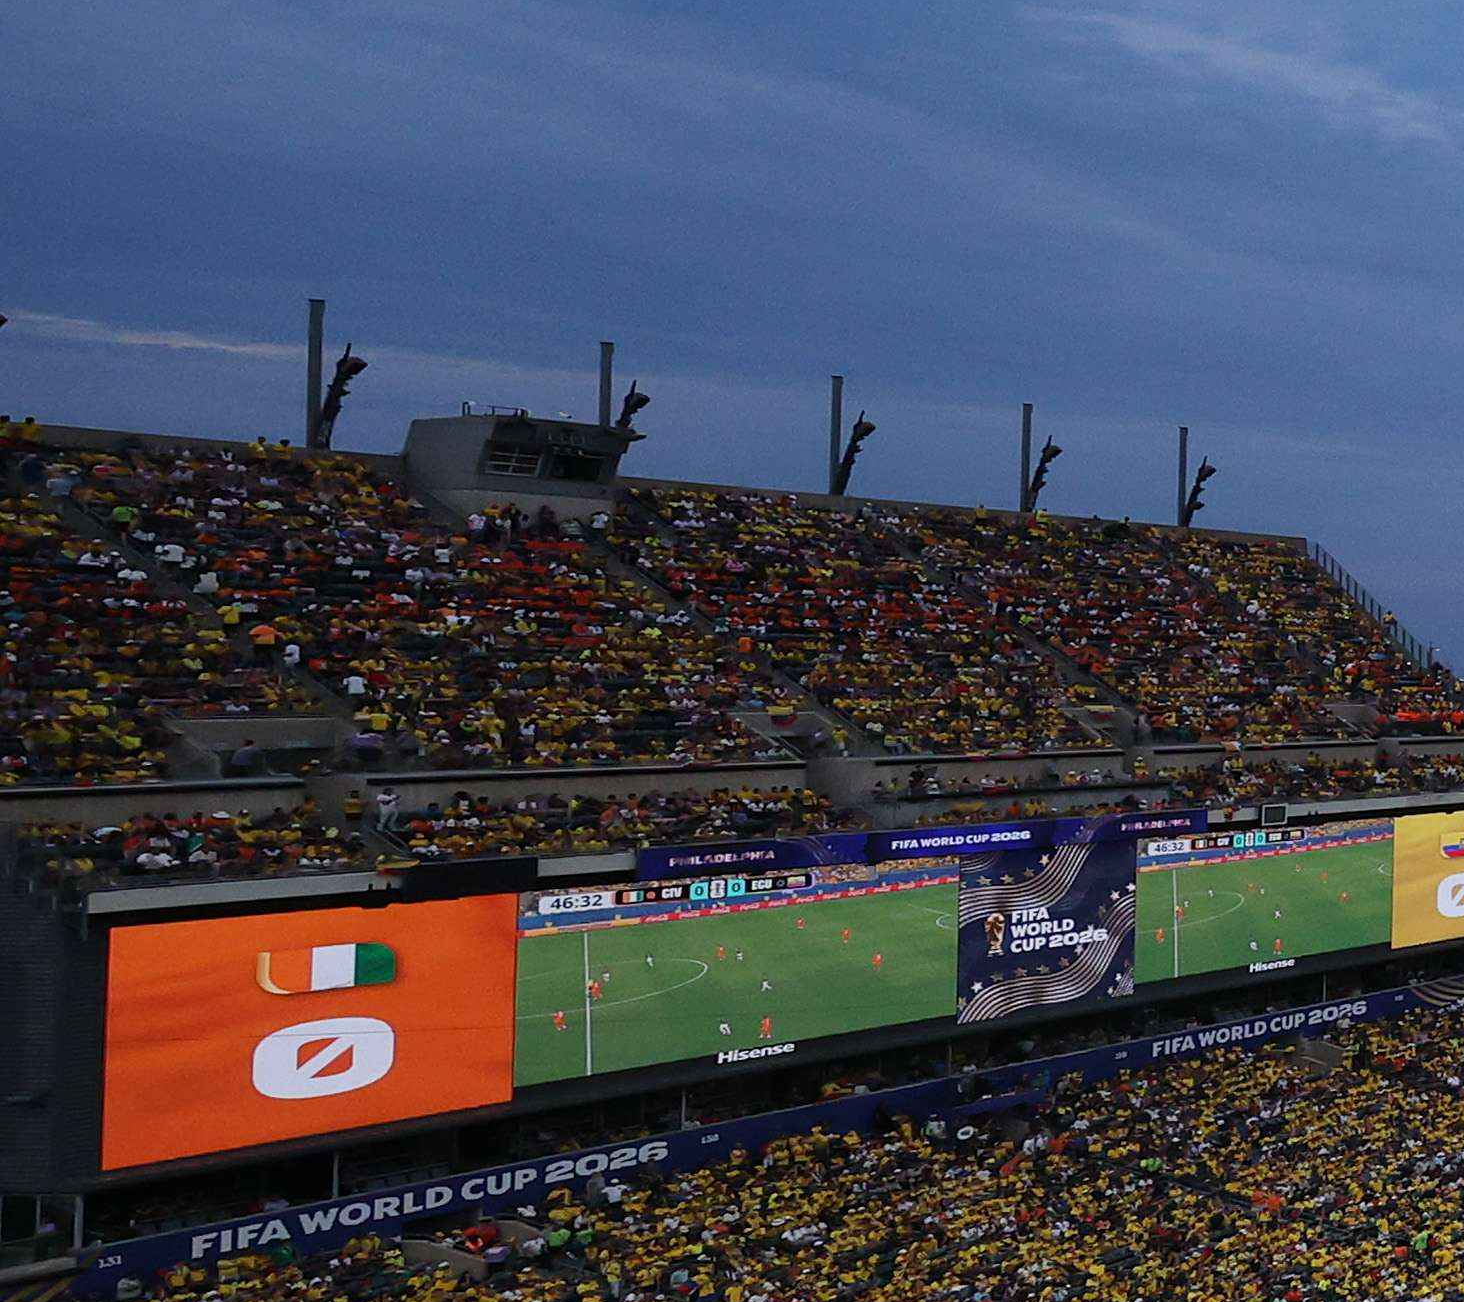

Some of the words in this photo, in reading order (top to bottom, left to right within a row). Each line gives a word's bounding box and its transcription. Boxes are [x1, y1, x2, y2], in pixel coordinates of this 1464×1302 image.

[891, 839, 919, 850] FIFA
[920, 836, 964, 849] WORLD
[965, 833, 990, 844] CUP
[990, 830, 1031, 842] 2026
[550, 894, 602, 910] 46:32
[751, 879, 772, 891] ECU
[1011, 907, 1049, 923] FIFA
[1010, 918, 1075, 938] WORLD
[1010, 936, 1046, 953] CUP
[1049, 928, 1108, 948] 2026
[1250, 958, 1295, 974] Hisense
[1152, 1035, 1195, 1058] FIFA
[1199, 1021, 1268, 1048] WORLD
[1269, 1012, 1305, 1033] CUP
[1308, 1000, 1368, 1026] 2026
[717, 1041, 796, 1065] Hisense
[191, 1219, 290, 1259] FIFA
[299, 1186, 453, 1236] WORLD
[461, 1168, 538, 1200] CUP
[545, 1141, 669, 1184] 2026
